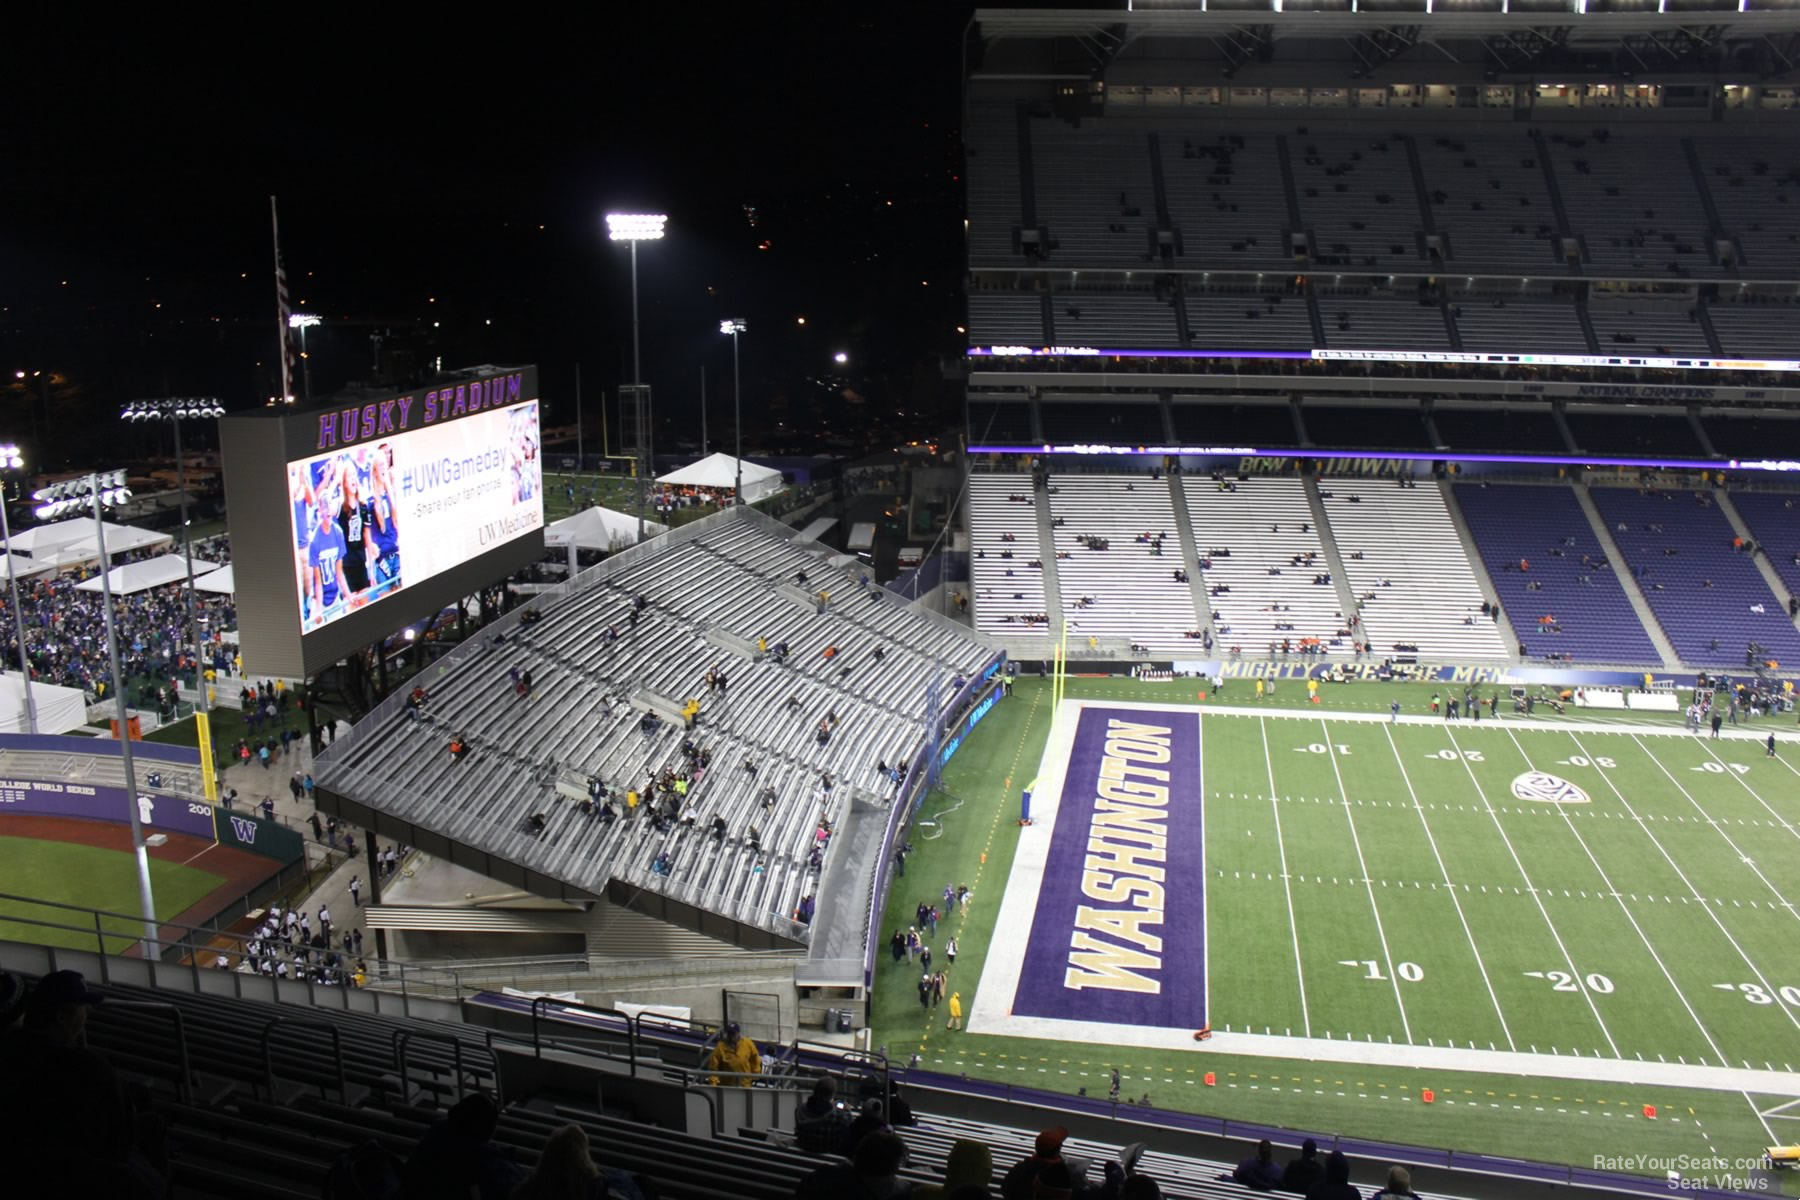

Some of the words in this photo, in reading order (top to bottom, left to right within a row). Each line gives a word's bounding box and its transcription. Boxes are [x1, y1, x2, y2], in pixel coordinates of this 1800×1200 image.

[1640, 386, 1716, 399] CHAMPIONS
[317, 396, 414, 449] HUSKY
[424, 373, 523, 423] STADIUM
[401, 446, 507, 497] #UWGameday
[1238, 457, 1287, 473] BOW
[443, 493, 461, 512] your
[463, 487, 476, 502] fan
[477, 479, 501, 499] photos
[478, 522, 499, 546] UW
[499, 510, 538, 537] Medicine
[1219, 662, 1320, 679] MIGHTY
[1452, 666, 1511, 684] MEN
[32, 782, 63, 793] WORLD
[66, 785, 96, 796] SERIES
[188, 803, 211, 817] 200
[230, 816, 257, 844] W
[1064, 719, 1172, 994] WASHINGTON
[1360, 959, 1425, 983] 10
[1546, 971, 1615, 994] 20
